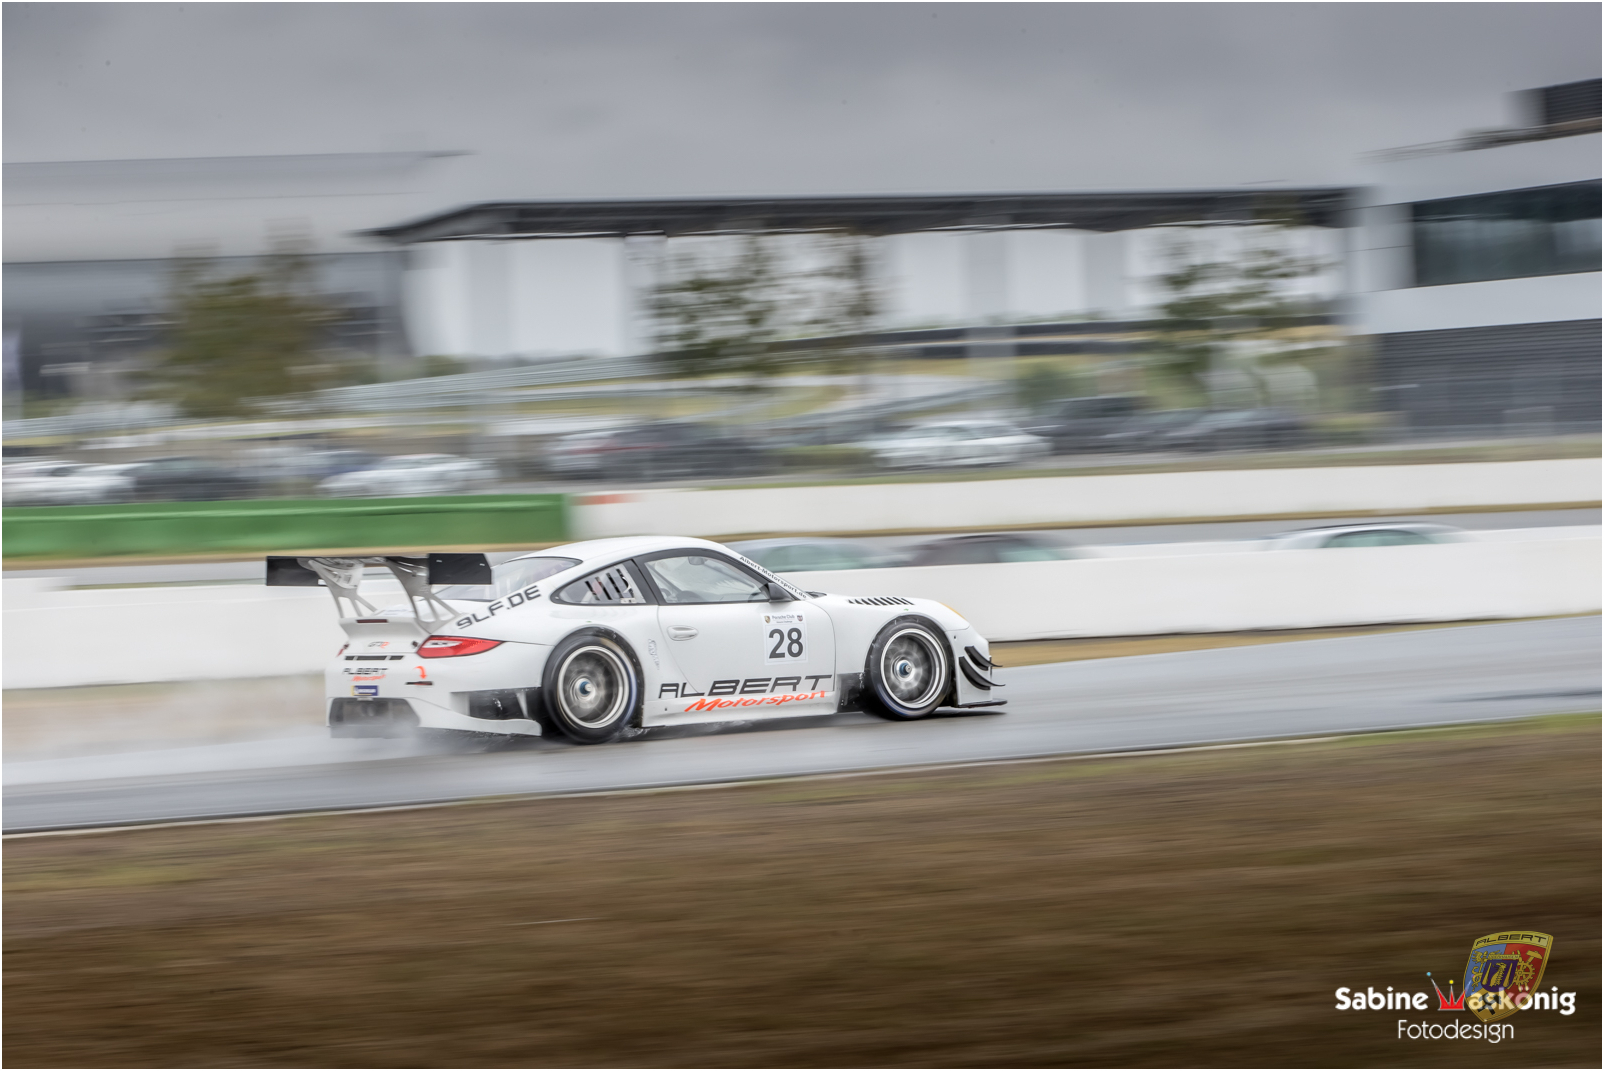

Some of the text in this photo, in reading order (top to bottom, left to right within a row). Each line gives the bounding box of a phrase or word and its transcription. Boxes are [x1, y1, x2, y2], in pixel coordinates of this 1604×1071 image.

[768, 627, 804, 659] 28
[658, 674, 832, 699] ALBERT
[684, 690, 827, 712] Motorsport
